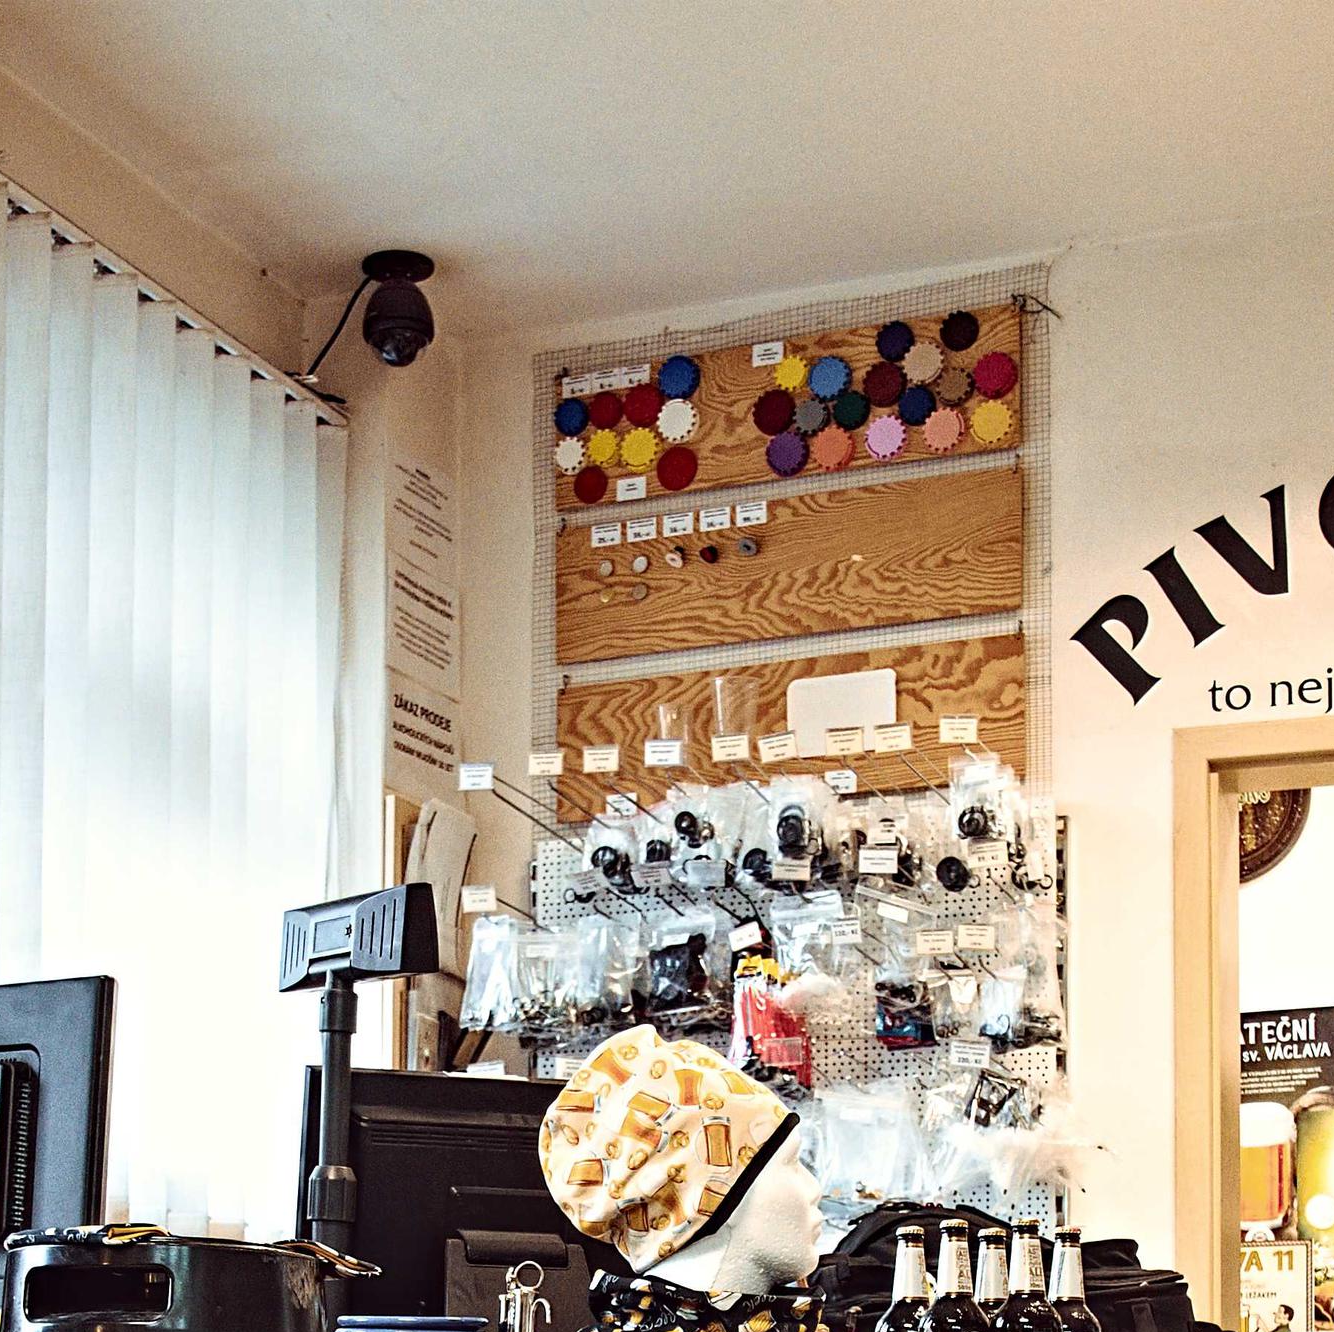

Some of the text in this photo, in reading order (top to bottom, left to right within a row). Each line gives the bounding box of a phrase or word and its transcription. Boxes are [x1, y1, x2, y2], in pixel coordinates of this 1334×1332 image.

[393, 693, 419, 718] ZÁKAZ
[1209, 678, 1252, 713] to
[1242, 1041, 1332, 1063] SV. VÁCLAVA
[1273, 1250, 1294, 1271] 11
